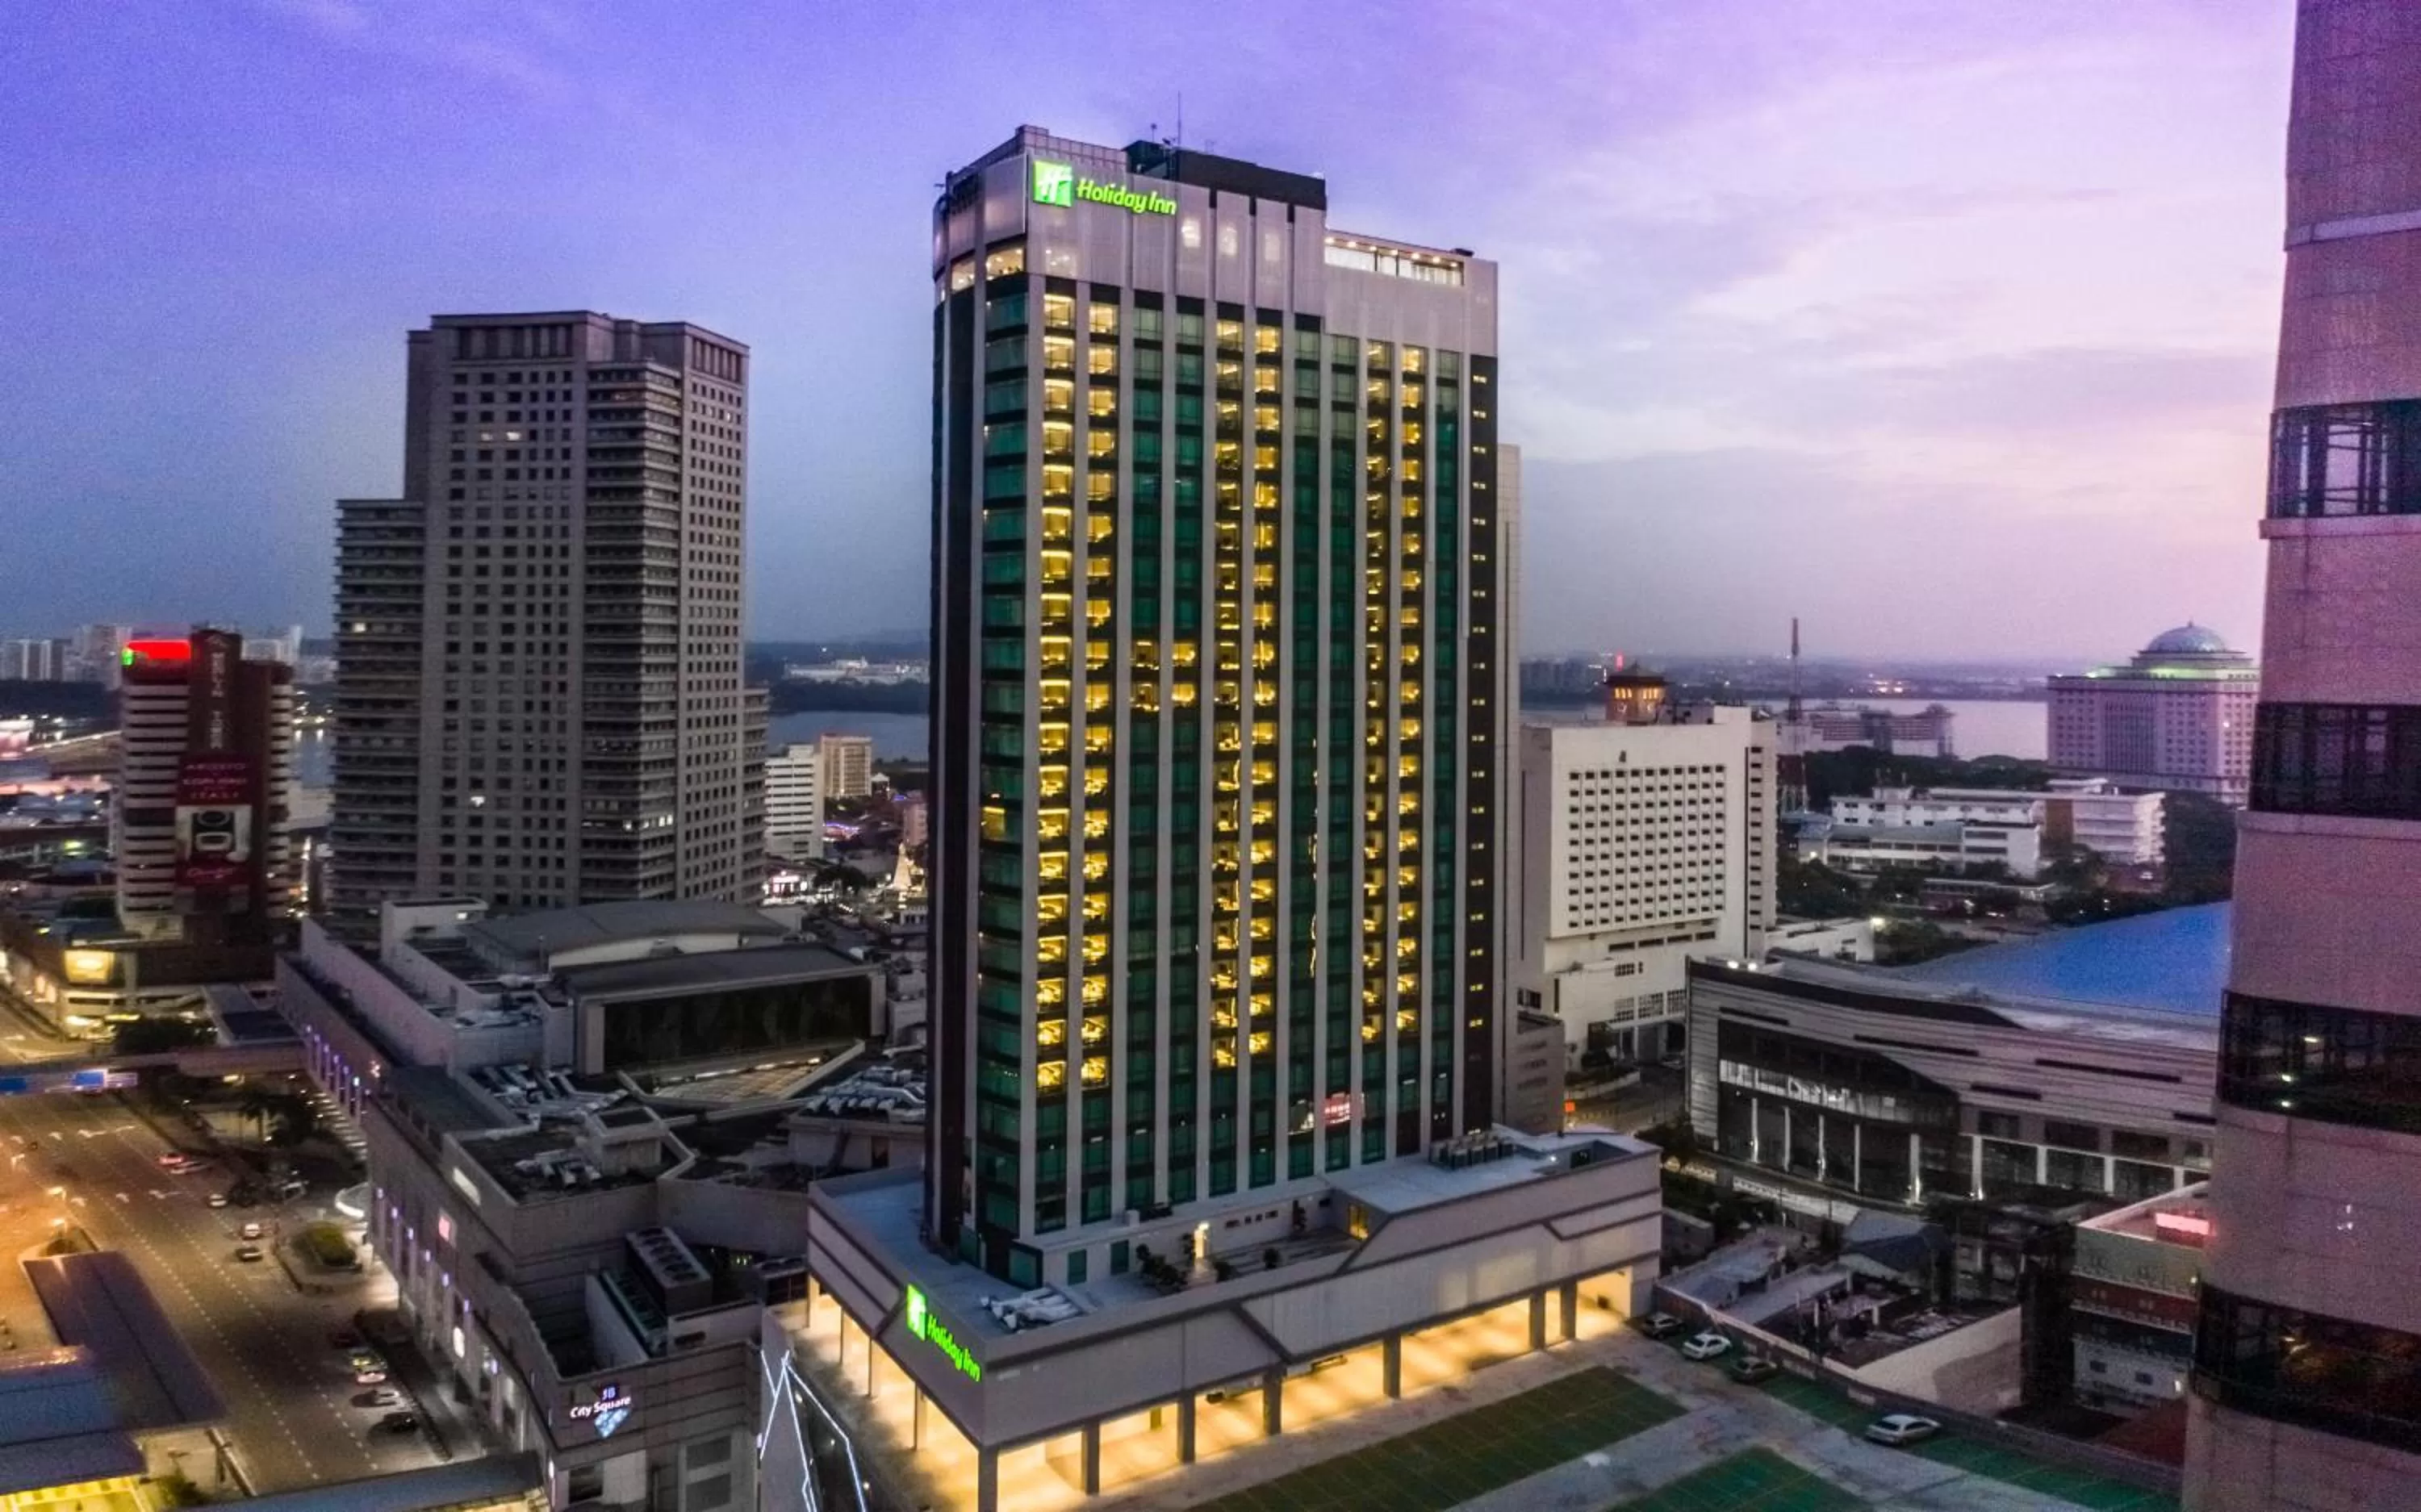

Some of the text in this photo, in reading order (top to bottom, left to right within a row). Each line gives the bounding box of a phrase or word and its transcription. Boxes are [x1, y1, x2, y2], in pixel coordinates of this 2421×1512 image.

[1076, 178, 1148, 213] Holiday
[1148, 190, 1177, 215] Inn
[927, 1314, 981, 1382] Holiday Inn
[570, 1396, 631, 1418] City Square
